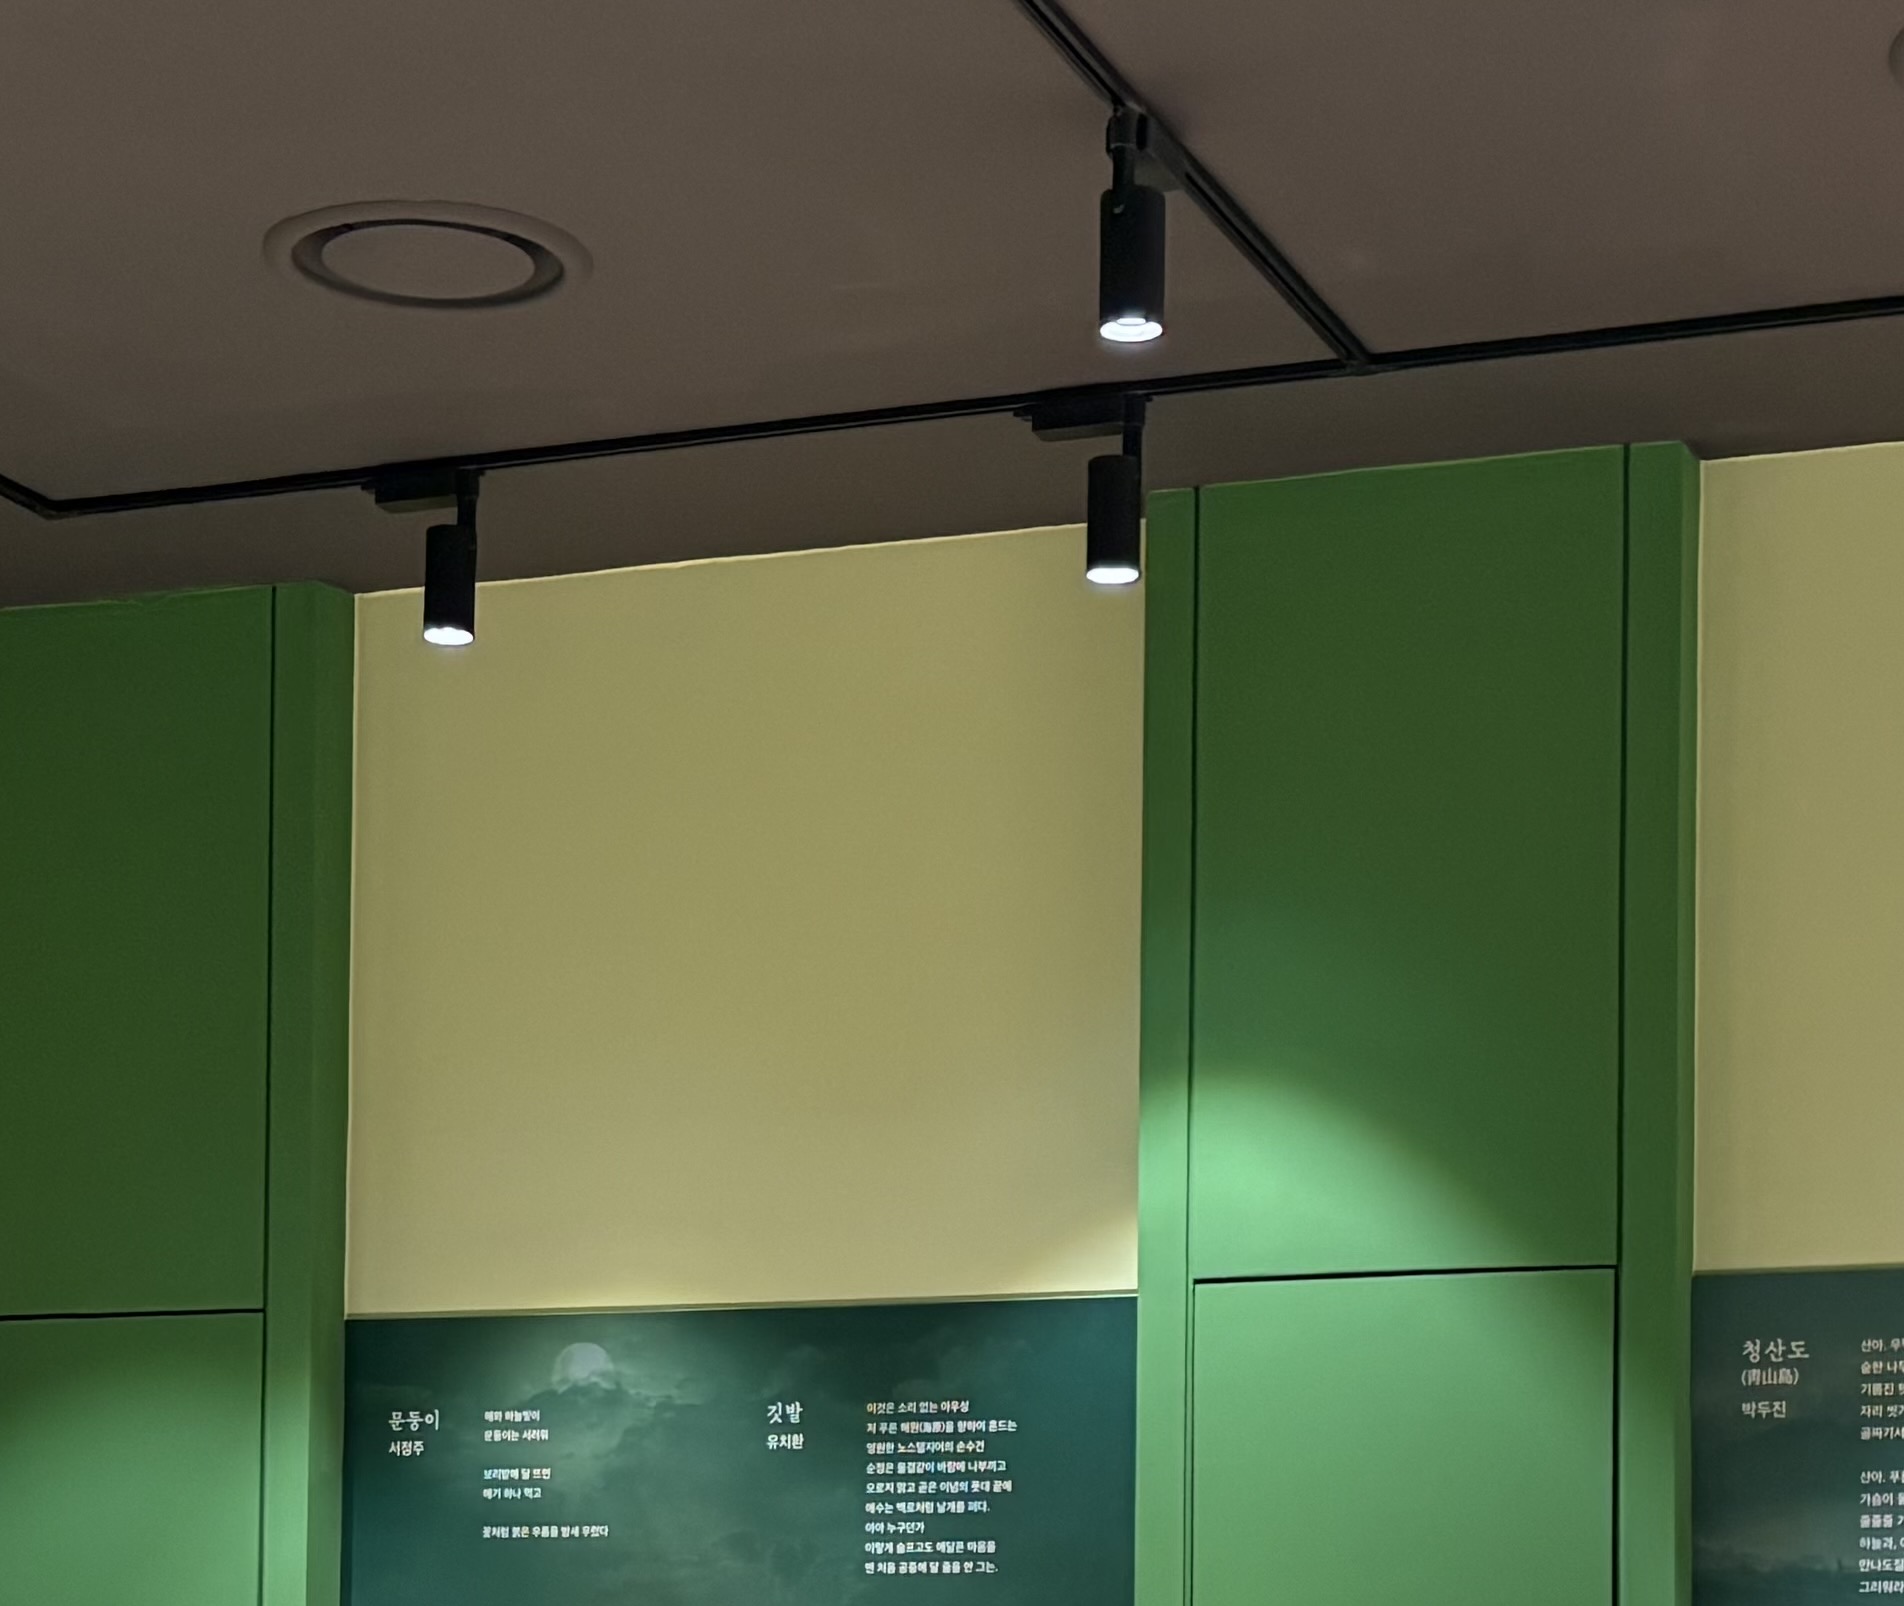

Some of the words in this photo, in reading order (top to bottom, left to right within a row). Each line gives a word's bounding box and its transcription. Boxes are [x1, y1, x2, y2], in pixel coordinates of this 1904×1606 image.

[1742, 1338, 1809, 1362] 청산도
[388, 1409, 439, 1431] 문둥이
[767, 1401, 803, 1423] 깃발
[1741, 1400, 1786, 1418] 박두진
[388, 1440, 424, 1456] 서정주
